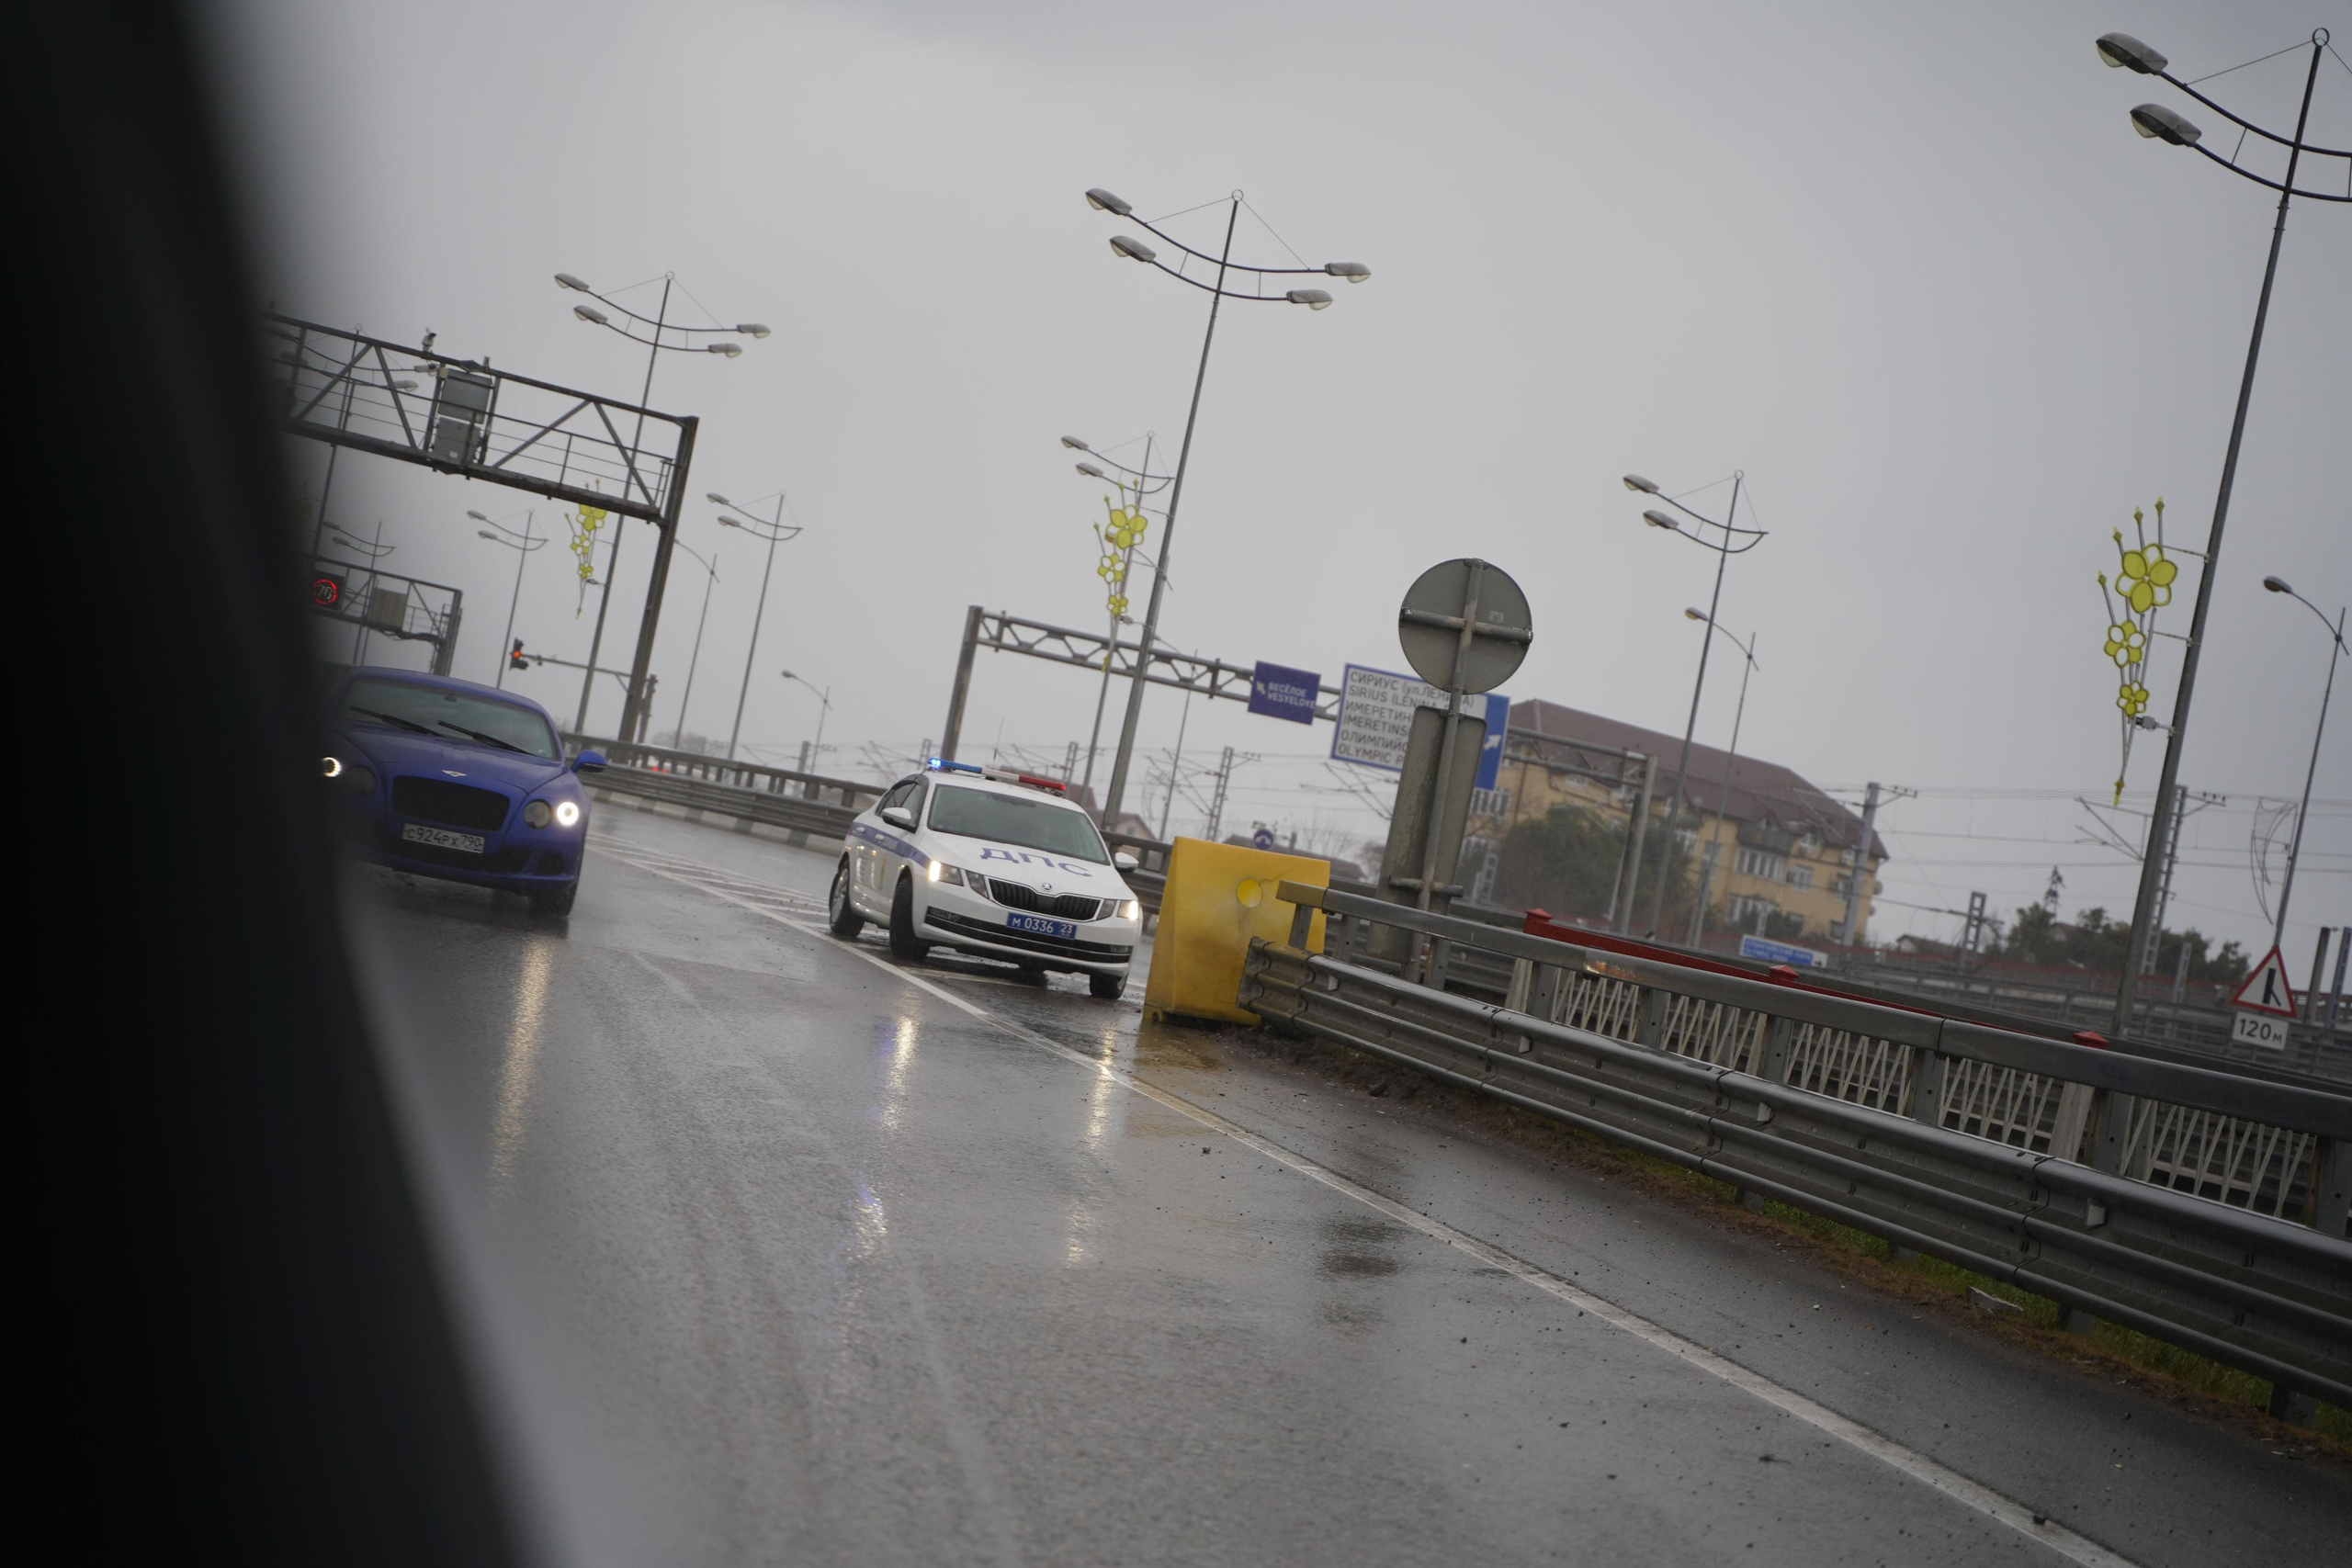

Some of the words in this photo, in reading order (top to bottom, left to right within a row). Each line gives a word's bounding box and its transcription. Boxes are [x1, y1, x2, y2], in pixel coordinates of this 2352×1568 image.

[1351, 671, 1398, 690] СИРИУС
[1349, 684, 1387, 703] SIRIUS
[1346, 700, 1411, 723] ИМЕРЕТИН
[1343, 714, 1410, 737] IMERETINS
[1340, 729, 1408, 752] ОЛИМПИЙС
[1339, 743, 1392, 763] OLYMPIC
[979, 847, 1092, 877] ДПС
[1024, 917, 1054, 933] 0336
[1060, 923, 1073, 934] 23
